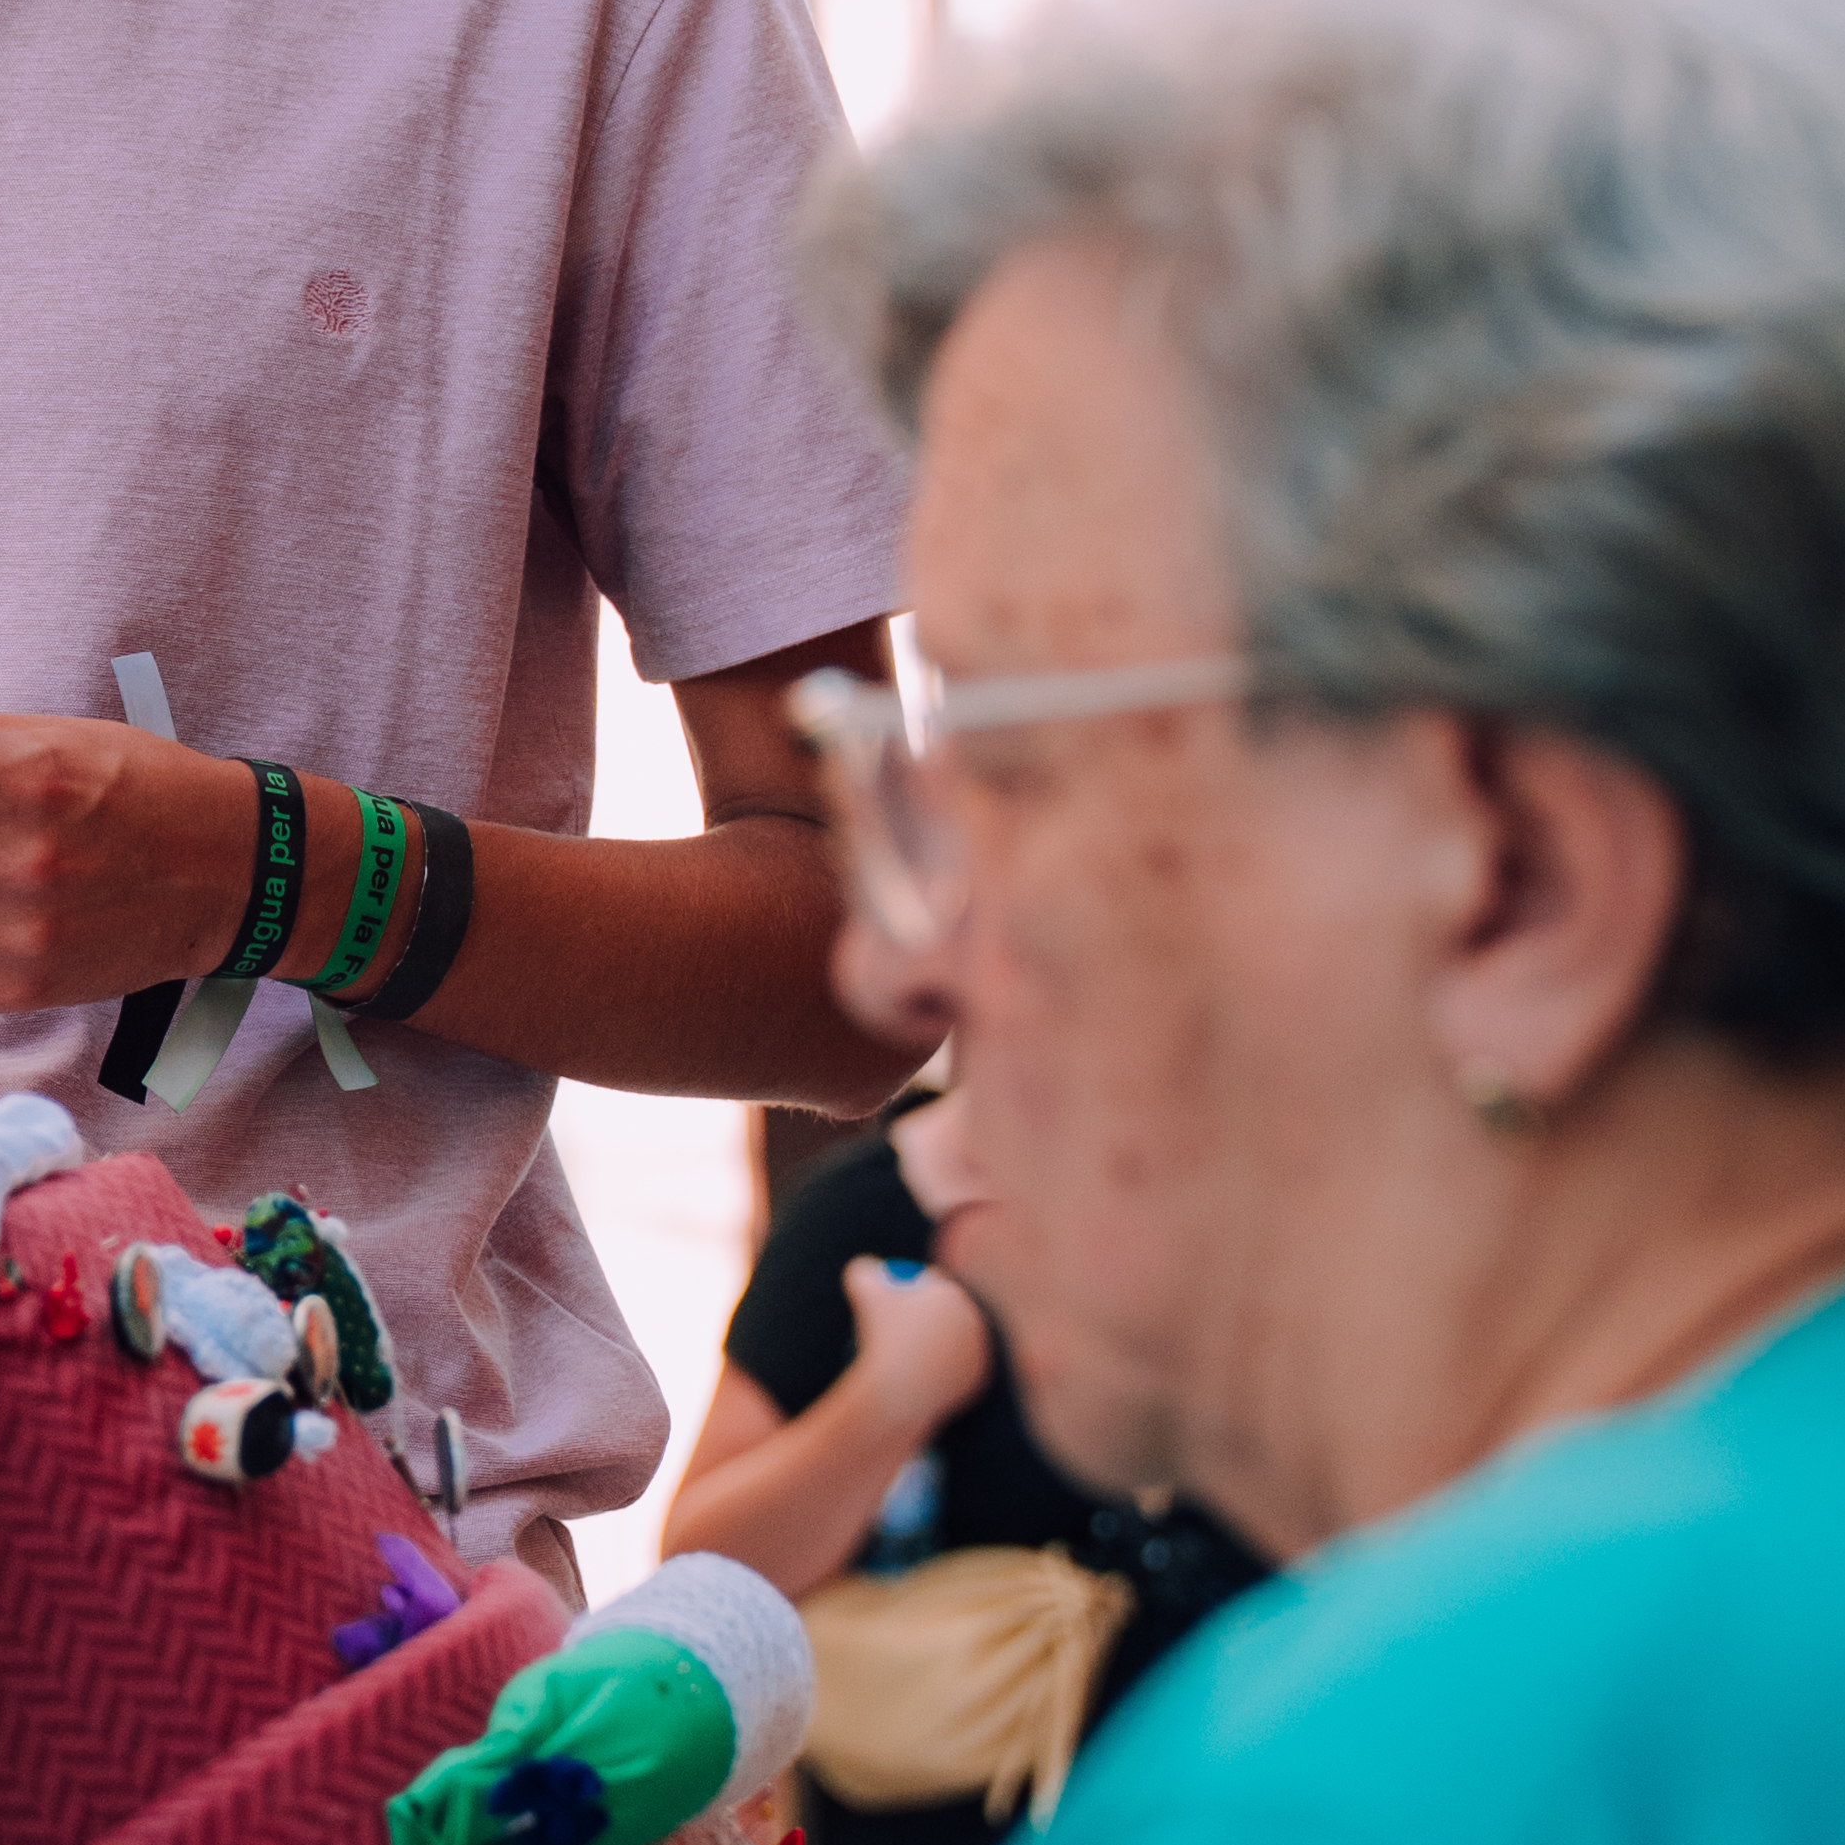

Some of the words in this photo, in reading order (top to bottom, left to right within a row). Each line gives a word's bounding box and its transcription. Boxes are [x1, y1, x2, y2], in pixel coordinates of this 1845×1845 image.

[265, 771, 289, 796] la
[270, 805, 295, 866] per
[368, 845, 395, 906] per
[353, 914, 382, 945] la
